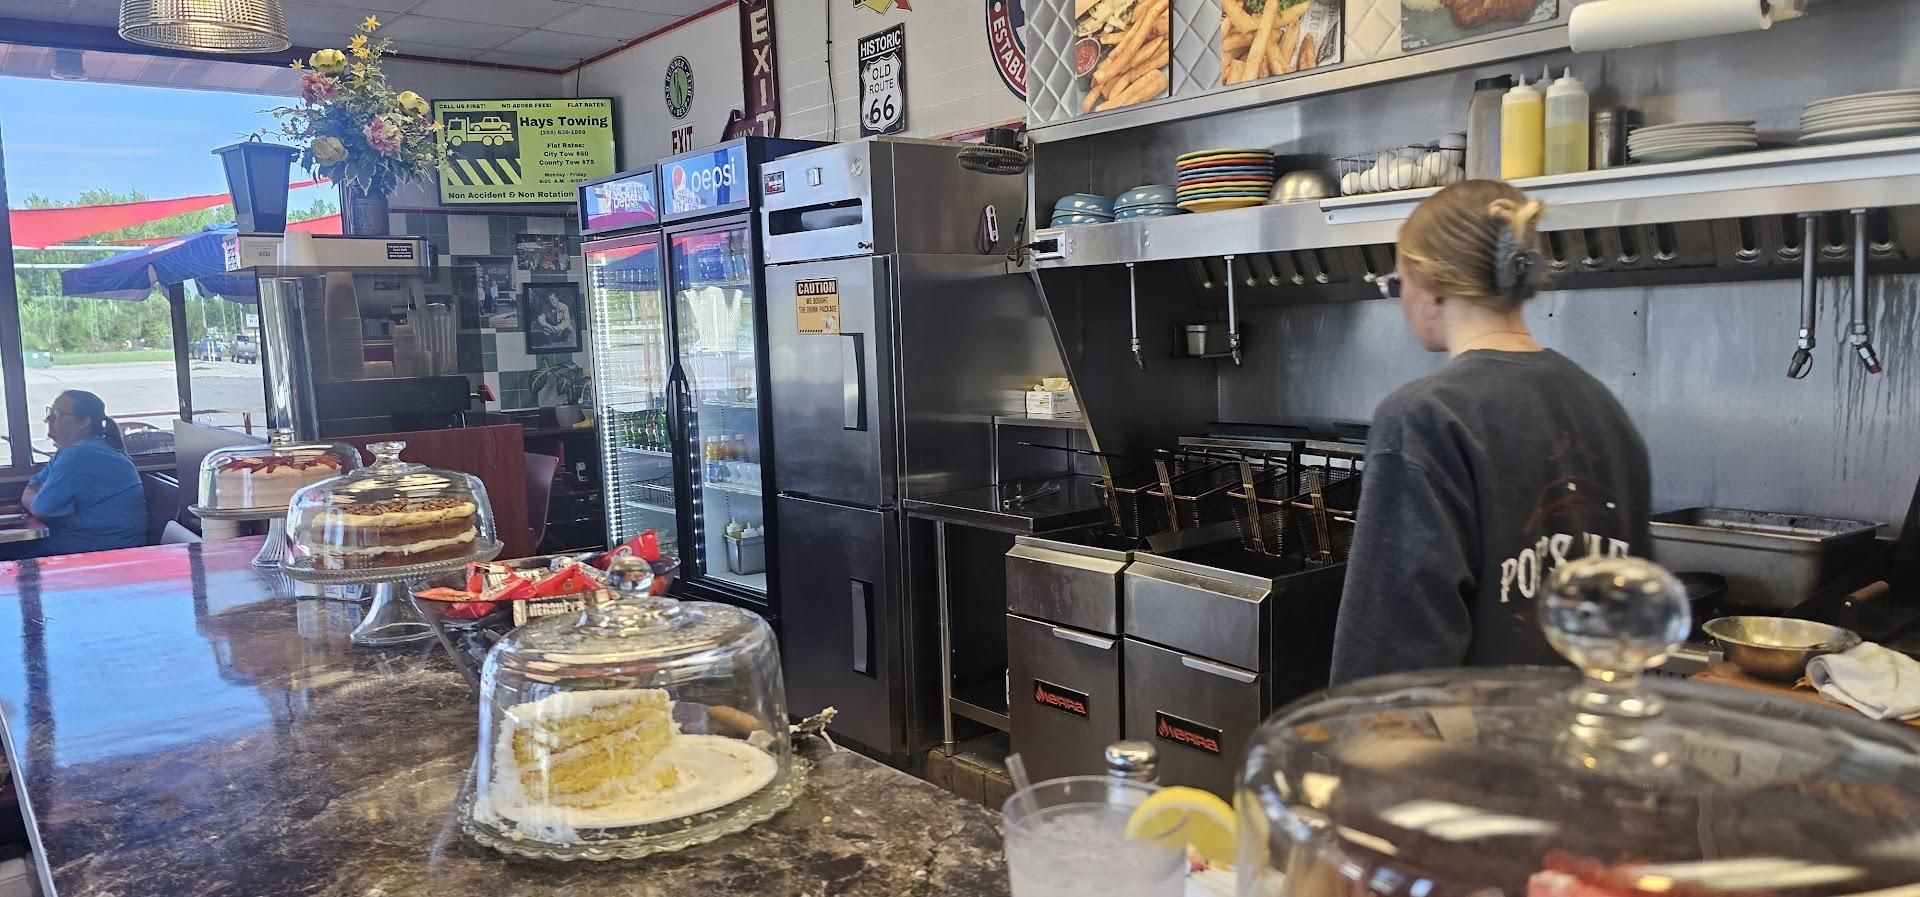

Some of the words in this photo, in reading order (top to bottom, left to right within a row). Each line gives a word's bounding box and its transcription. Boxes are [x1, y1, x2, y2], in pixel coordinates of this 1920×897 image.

[860, 30, 902, 58] HISTORIC
[750, 7, 776, 138] EXIT
[872, 63, 892, 81] OLD
[869, 78, 894, 94] ROUTE
[869, 94, 895, 124] 66
[520, 116, 554, 128] Hays
[558, 116, 608, 128] Towing
[672, 126, 692, 156] EXIT
[798, 282, 835, 294] CAUTION
[529, 599, 585, 617] HERSHEY'S
